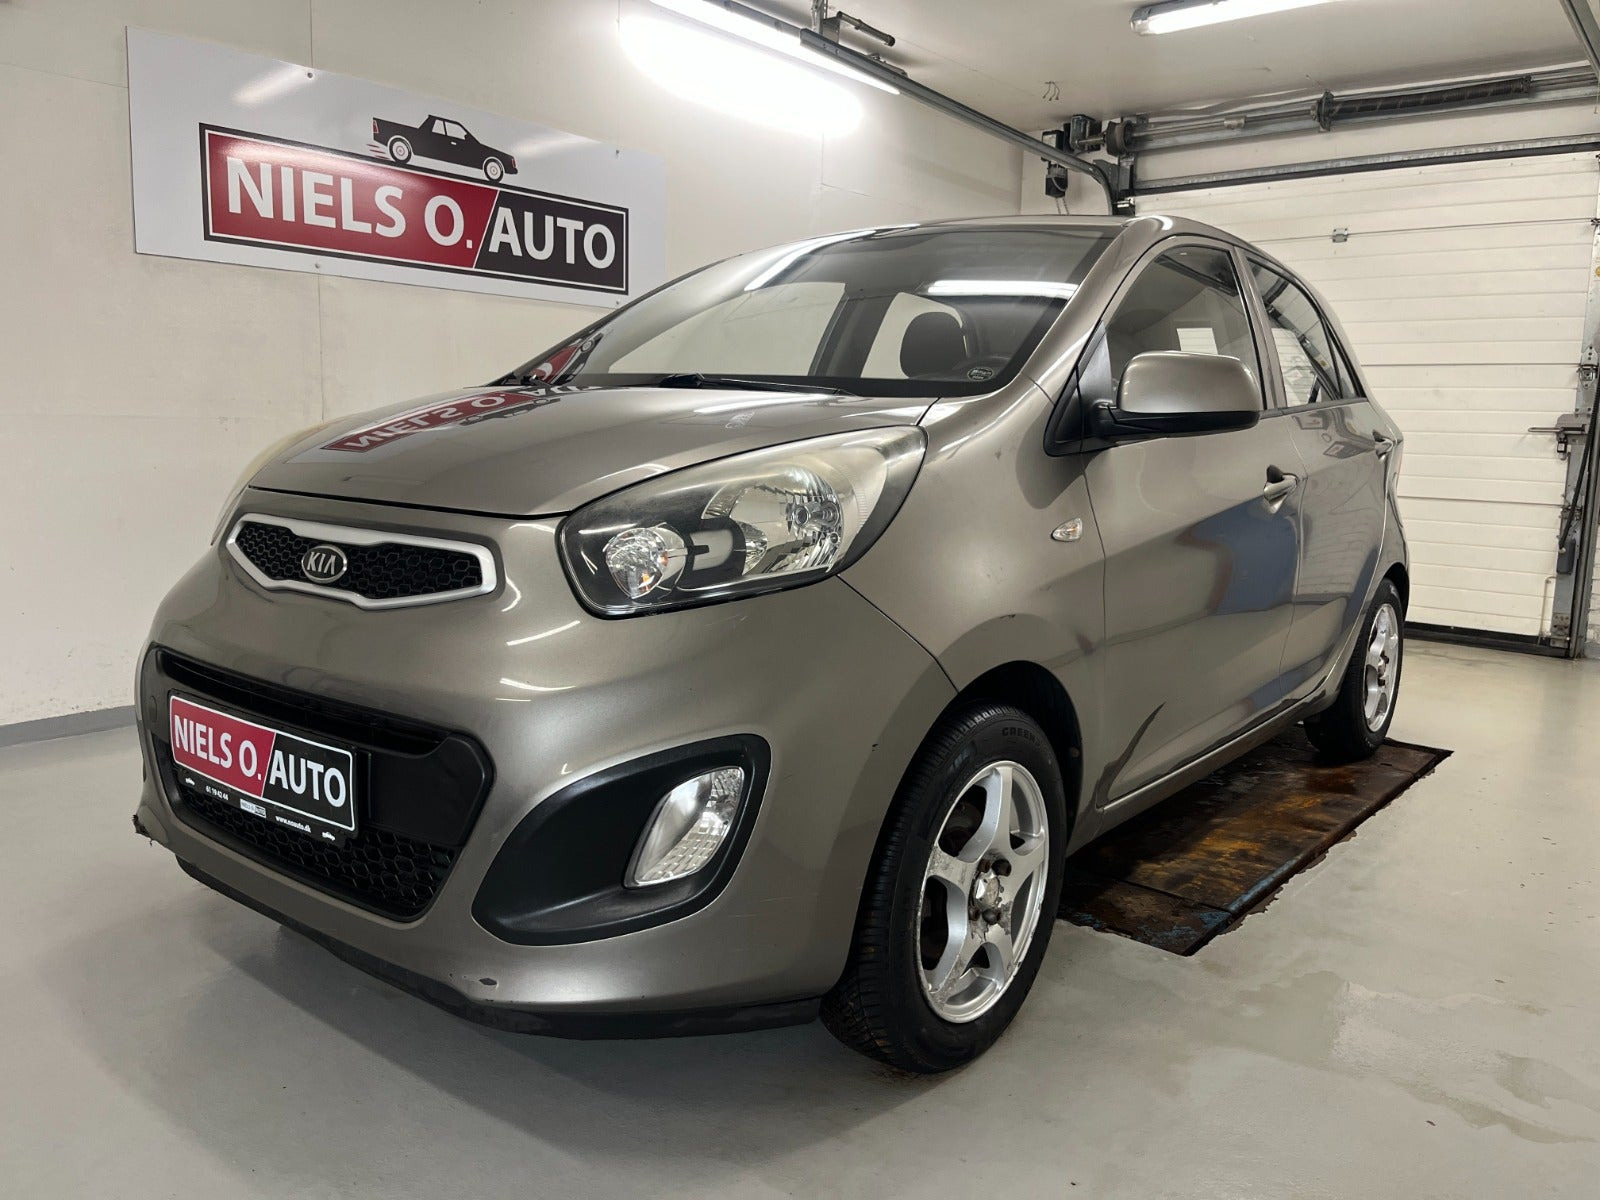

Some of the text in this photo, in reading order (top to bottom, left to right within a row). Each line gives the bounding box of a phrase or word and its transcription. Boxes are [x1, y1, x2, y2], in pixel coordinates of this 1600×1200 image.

[227, 157, 616, 269] NIELS O. AUTO
[306, 551, 336, 575] KIA
[173, 714, 346, 808] NIELS O. AUTO
